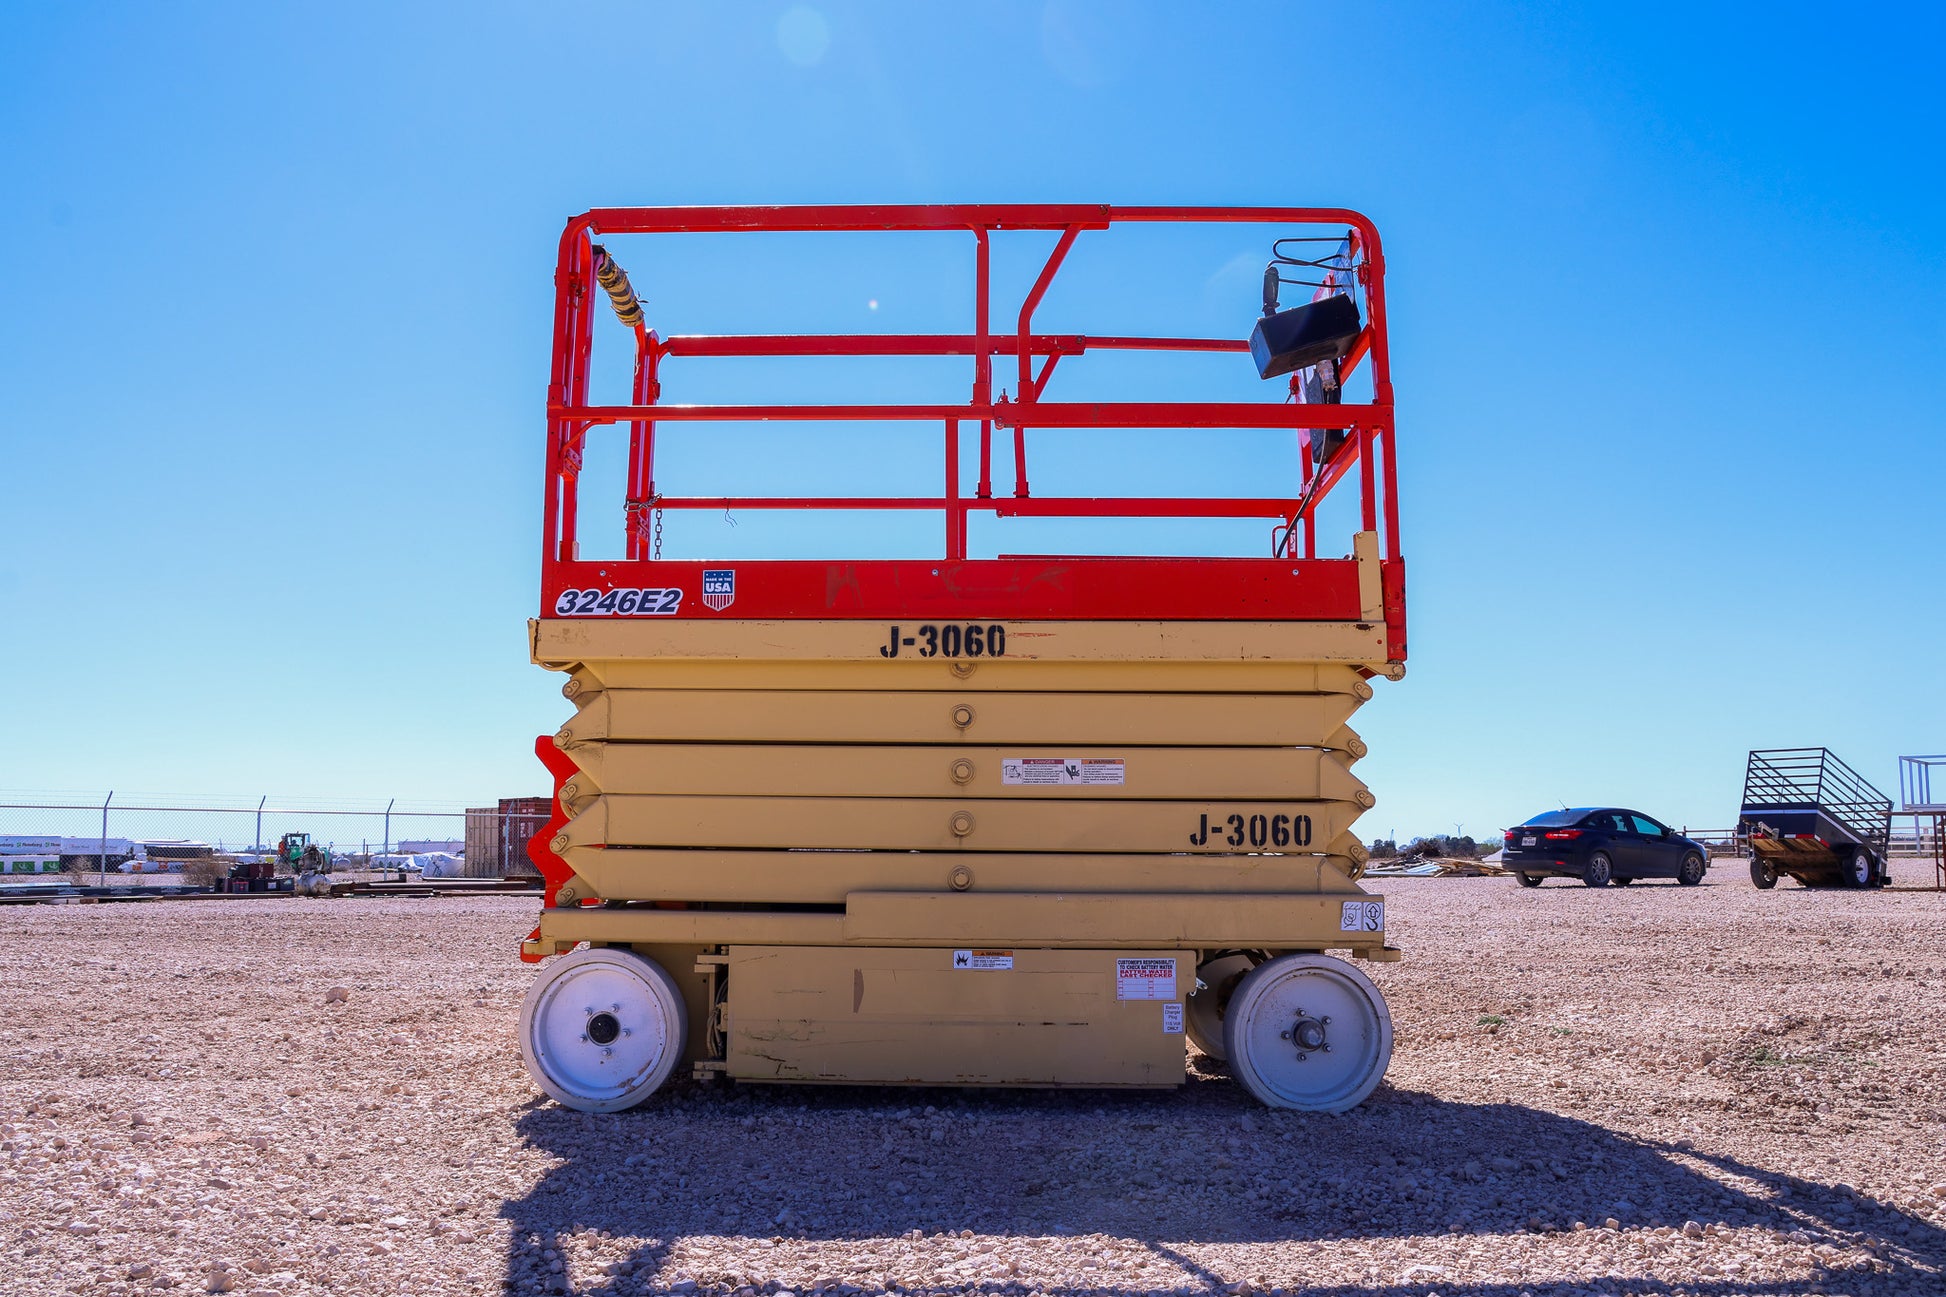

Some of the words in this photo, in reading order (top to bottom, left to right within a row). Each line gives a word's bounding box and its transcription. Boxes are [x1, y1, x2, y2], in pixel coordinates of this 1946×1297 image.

[556, 589, 682, 614] 3246E2
[705, 582, 732, 592] USA
[880, 625, 1006, 658] J-3060
[1190, 814, 1312, 847] J-3060
